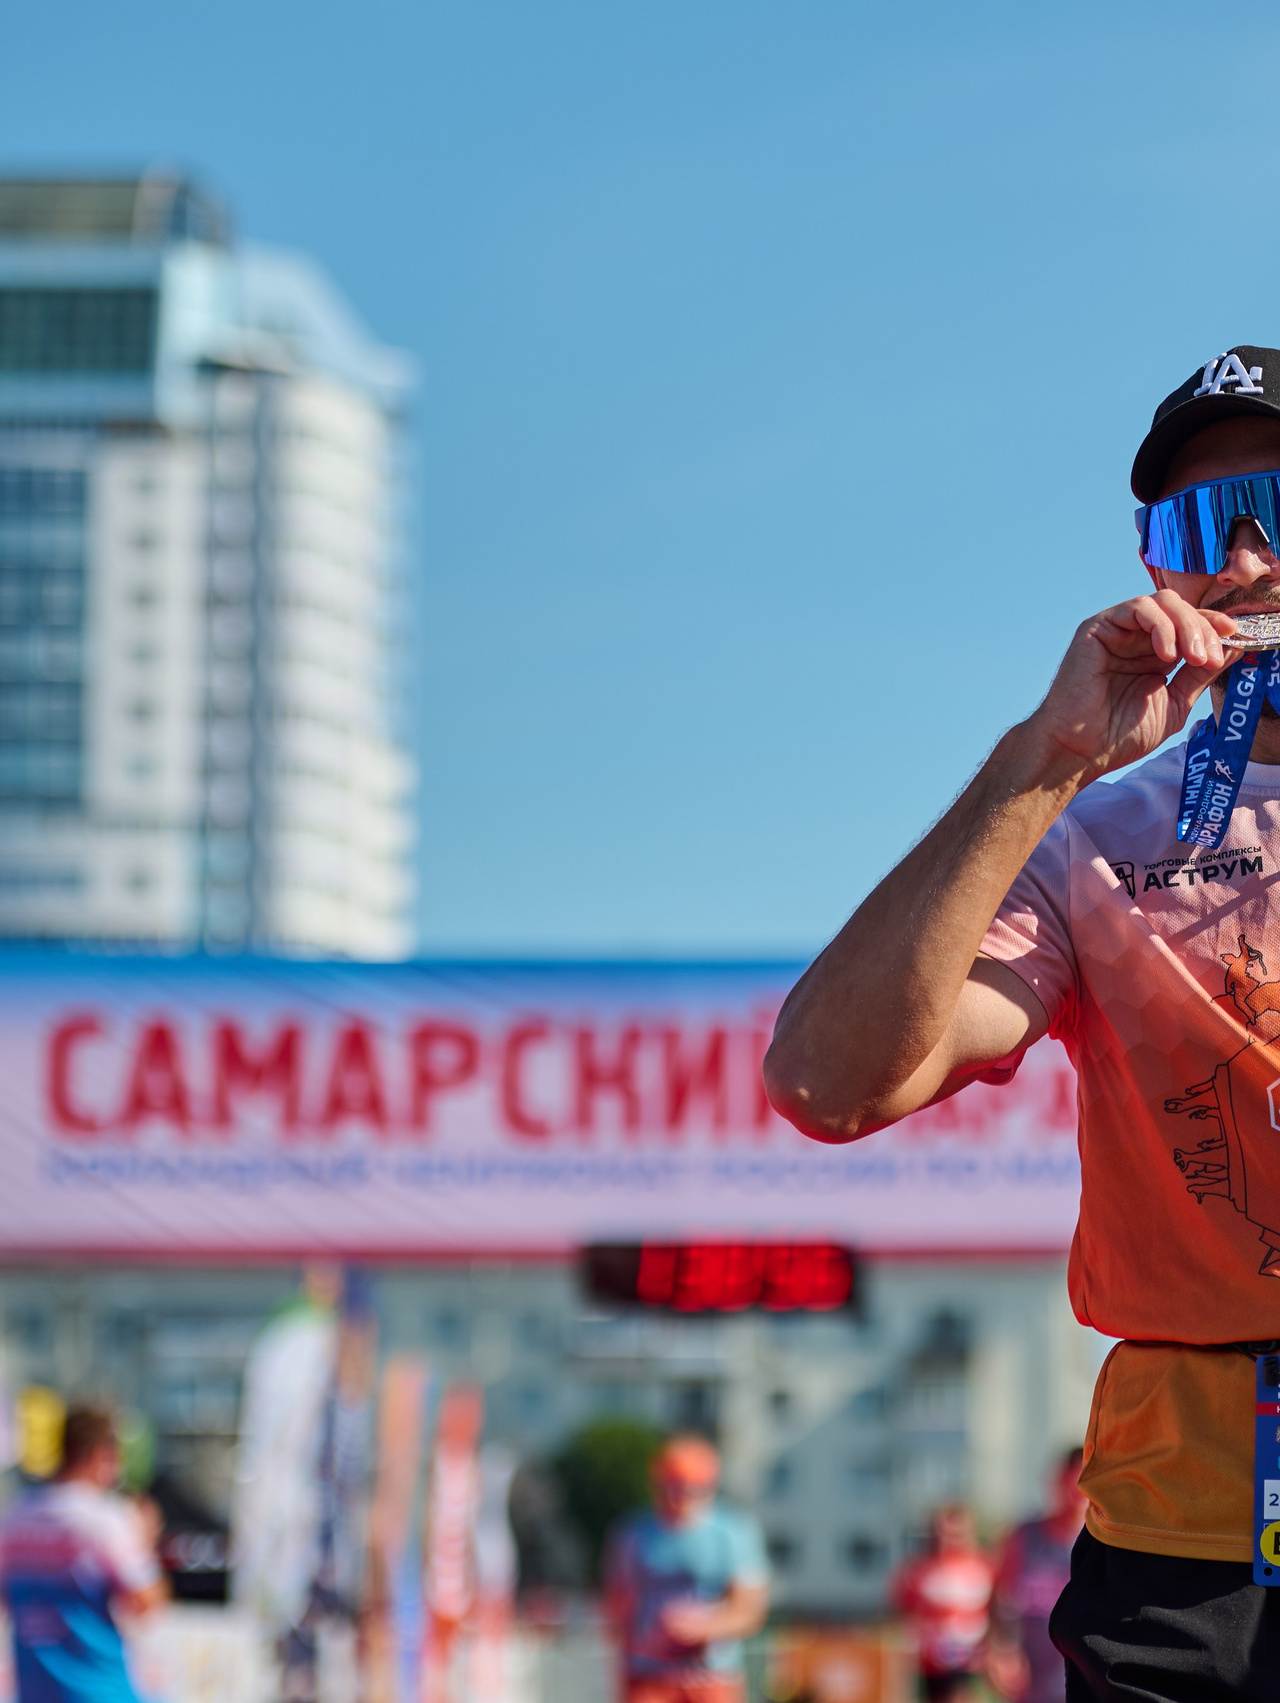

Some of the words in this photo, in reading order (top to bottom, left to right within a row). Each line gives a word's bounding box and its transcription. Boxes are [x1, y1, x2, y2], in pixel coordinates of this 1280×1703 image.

[1194, 352, 1263, 397] LA
[1224, 650, 1262, 742] VOLGAM
[1187, 780, 1215, 844] ЕЖДУНАРОДНЫЙ
[1143, 857, 1196, 871] ТОРГОВЫЕ
[1200, 846, 1261, 863] КОМПЛЕКСЫ
[1143, 856, 1264, 892] АСТРУМ
